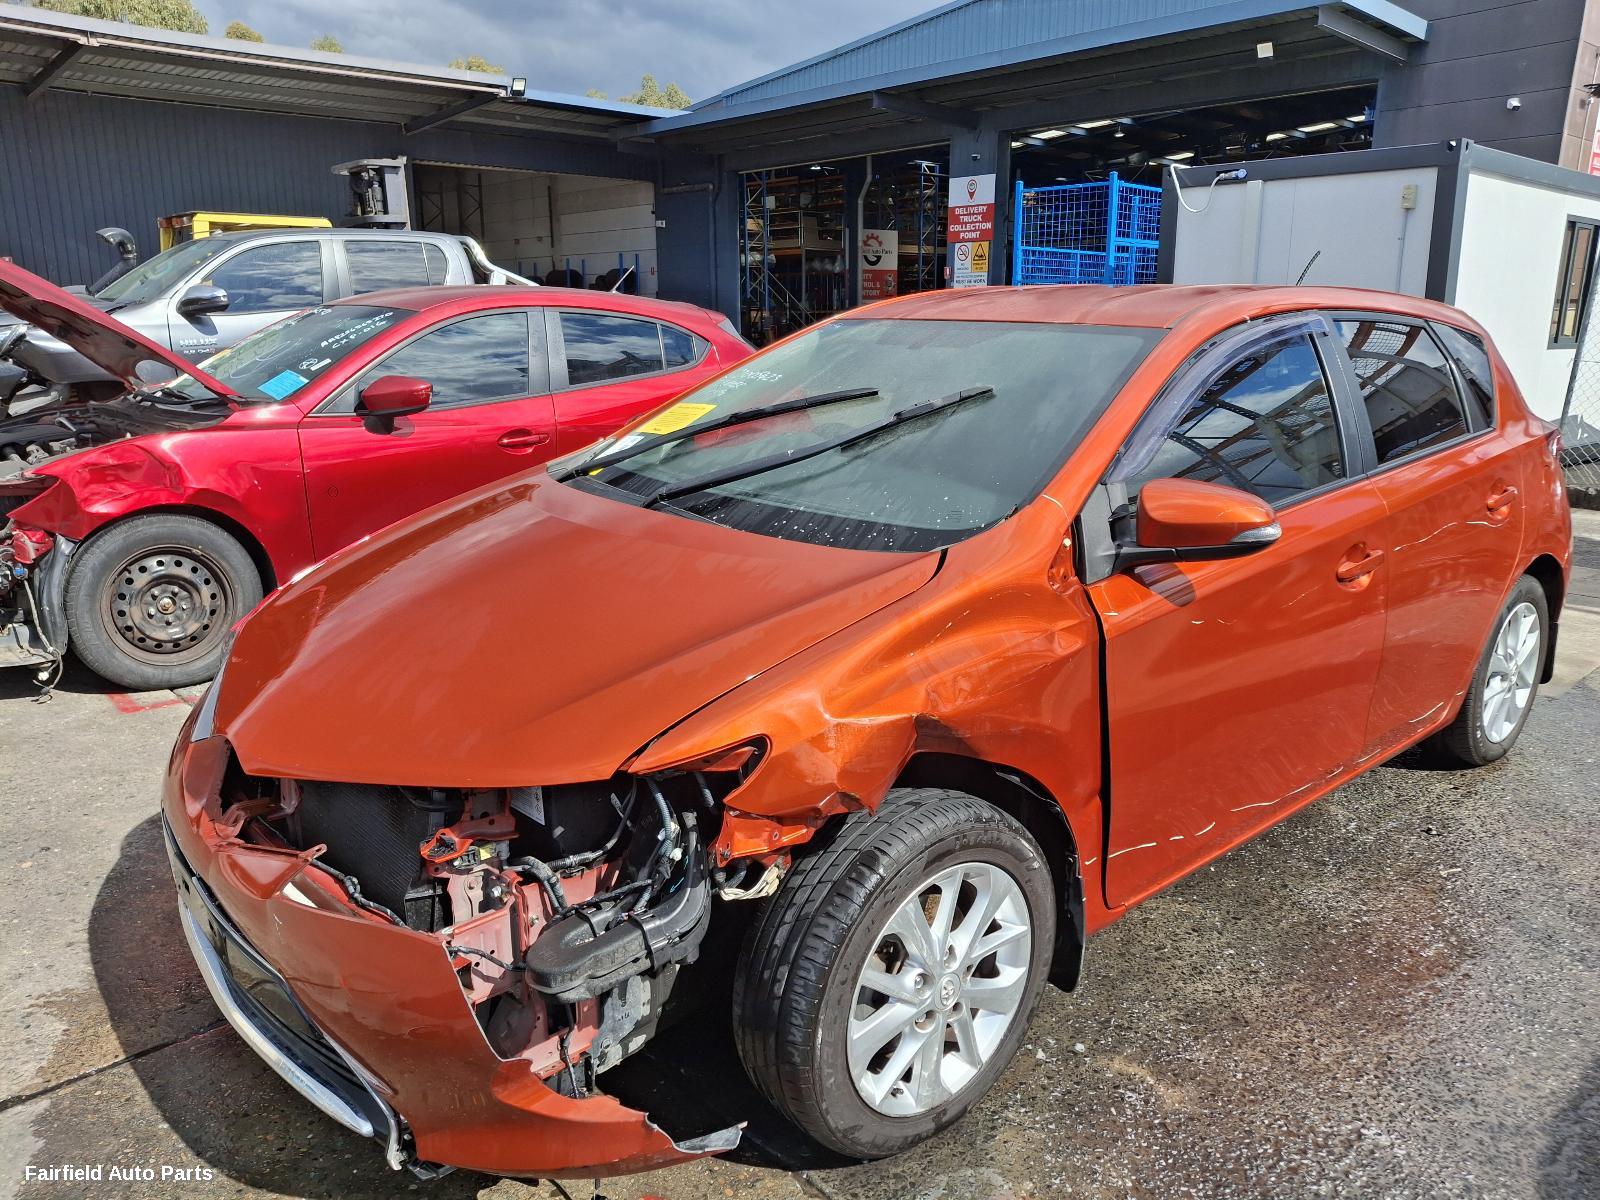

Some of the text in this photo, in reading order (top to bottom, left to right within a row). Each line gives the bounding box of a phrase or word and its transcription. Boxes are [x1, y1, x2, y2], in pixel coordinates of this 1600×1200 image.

[955, 206, 987, 214] DELIVERY
[950, 222, 992, 231] COLLECTION
[960, 231, 980, 239] POINT
